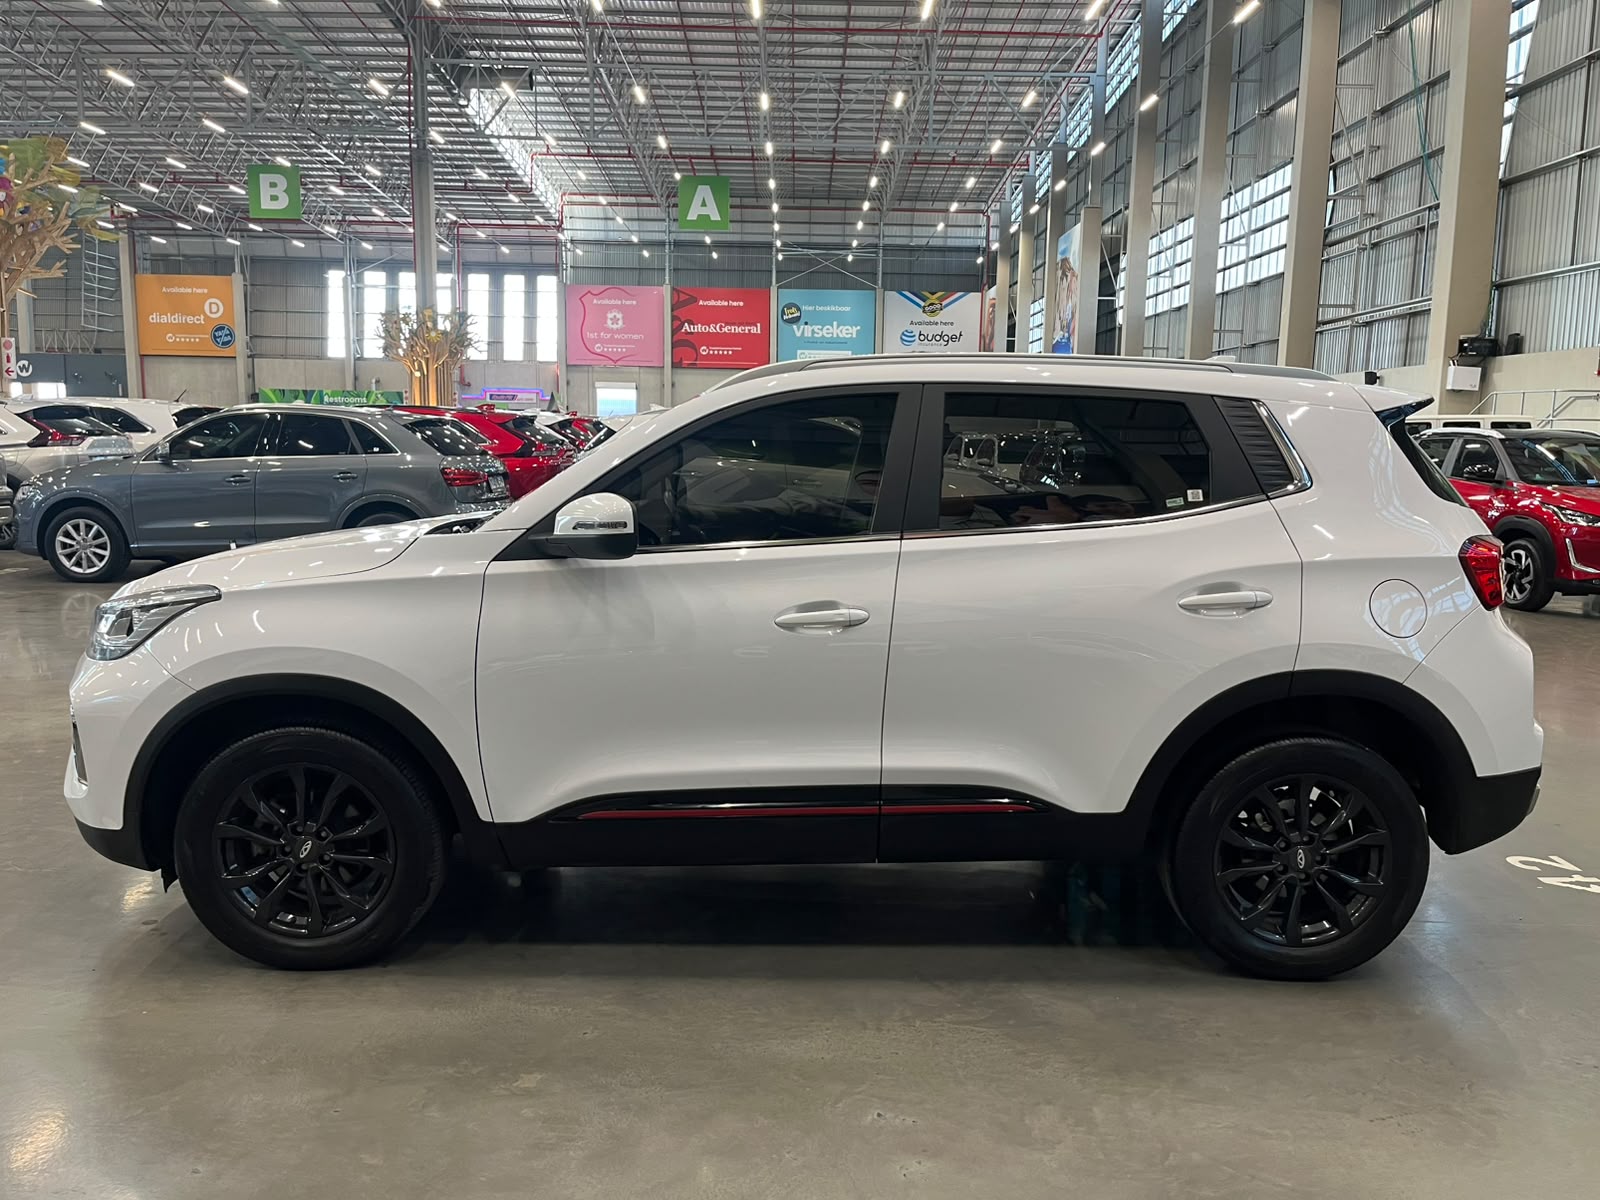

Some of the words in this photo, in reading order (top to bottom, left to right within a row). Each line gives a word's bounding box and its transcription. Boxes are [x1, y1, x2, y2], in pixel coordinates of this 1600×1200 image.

[259, 173, 289, 210] B
[686, 185, 721, 221] A
[161, 286, 192, 294] Available
[816, 304, 852, 312] beskikbaar
[148, 312, 206, 324] dialdirect
[681, 322, 761, 334] Auto&General
[792, 321, 861, 338] virseker
[586, 331, 599, 340] 1st
[600, 331, 612, 340] for
[614, 333, 645, 341] women
[917, 330, 964, 347] budget
[323, 394, 368, 404] Restrooms
